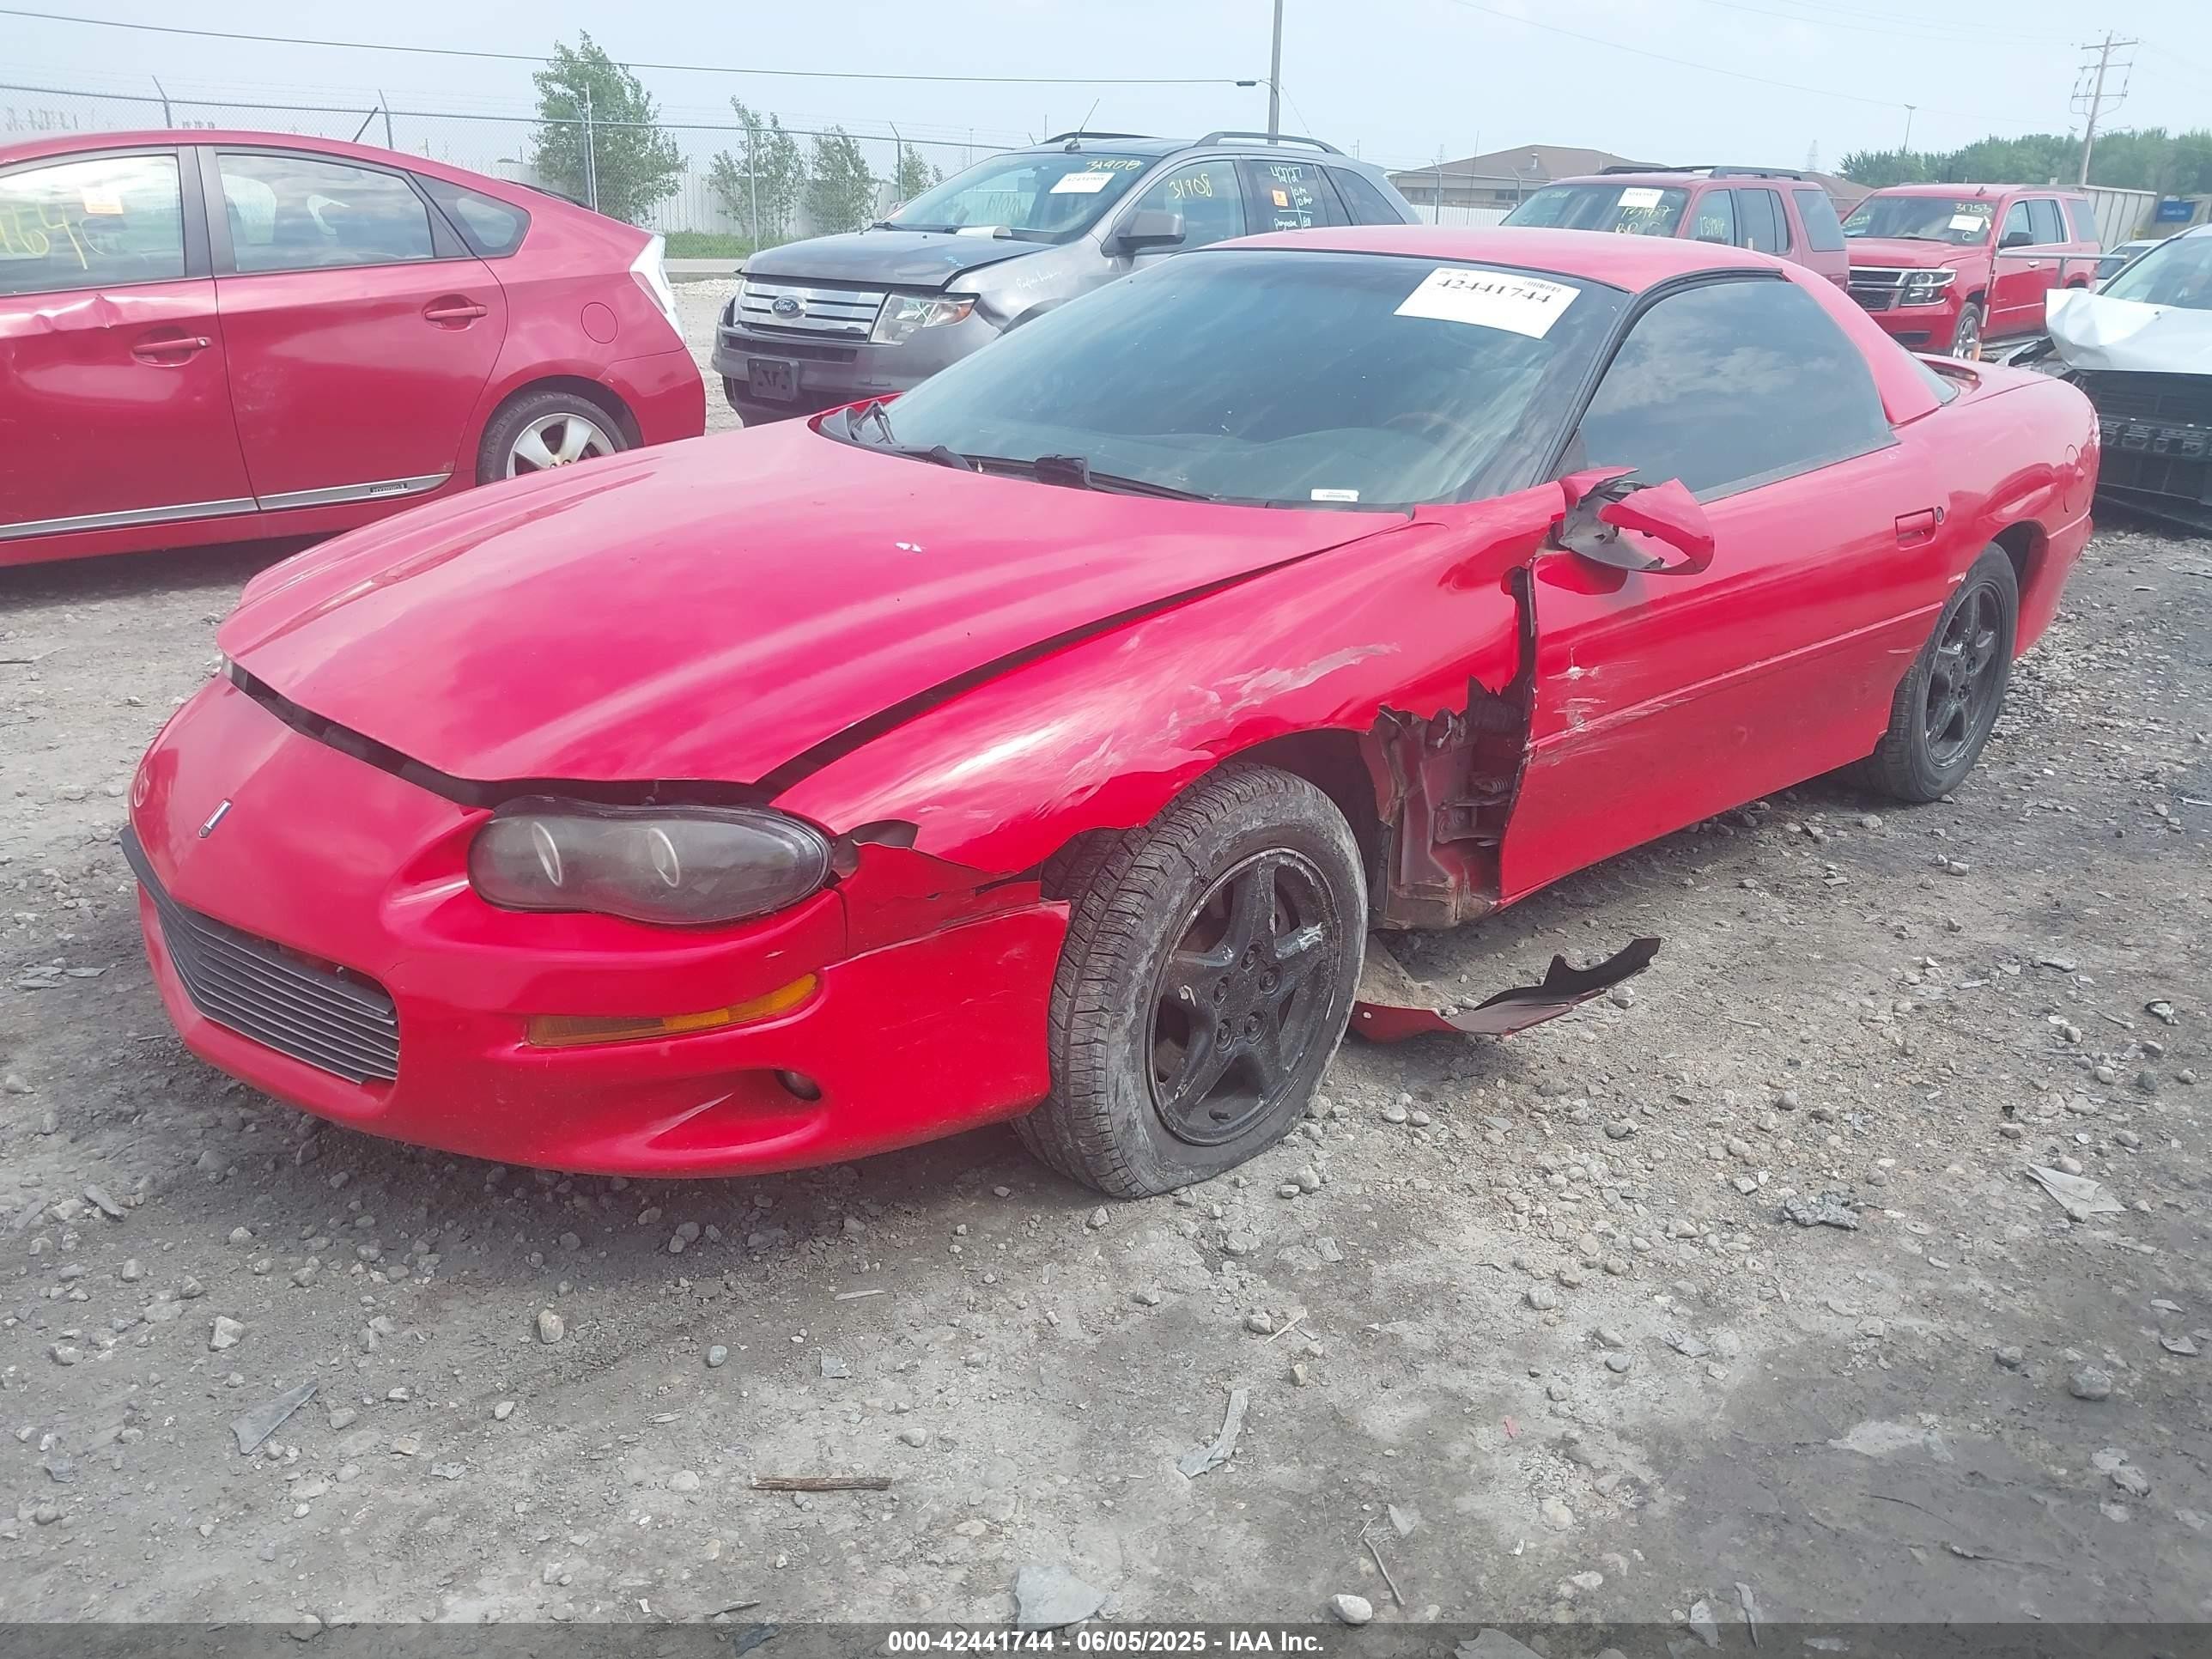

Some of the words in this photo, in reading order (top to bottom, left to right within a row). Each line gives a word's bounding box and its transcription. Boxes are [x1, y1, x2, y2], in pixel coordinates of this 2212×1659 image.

[1169, 173, 1212, 199] 31908
[1437, 278, 1552, 303] 42441744
[775, 300, 795, 310] Ford
